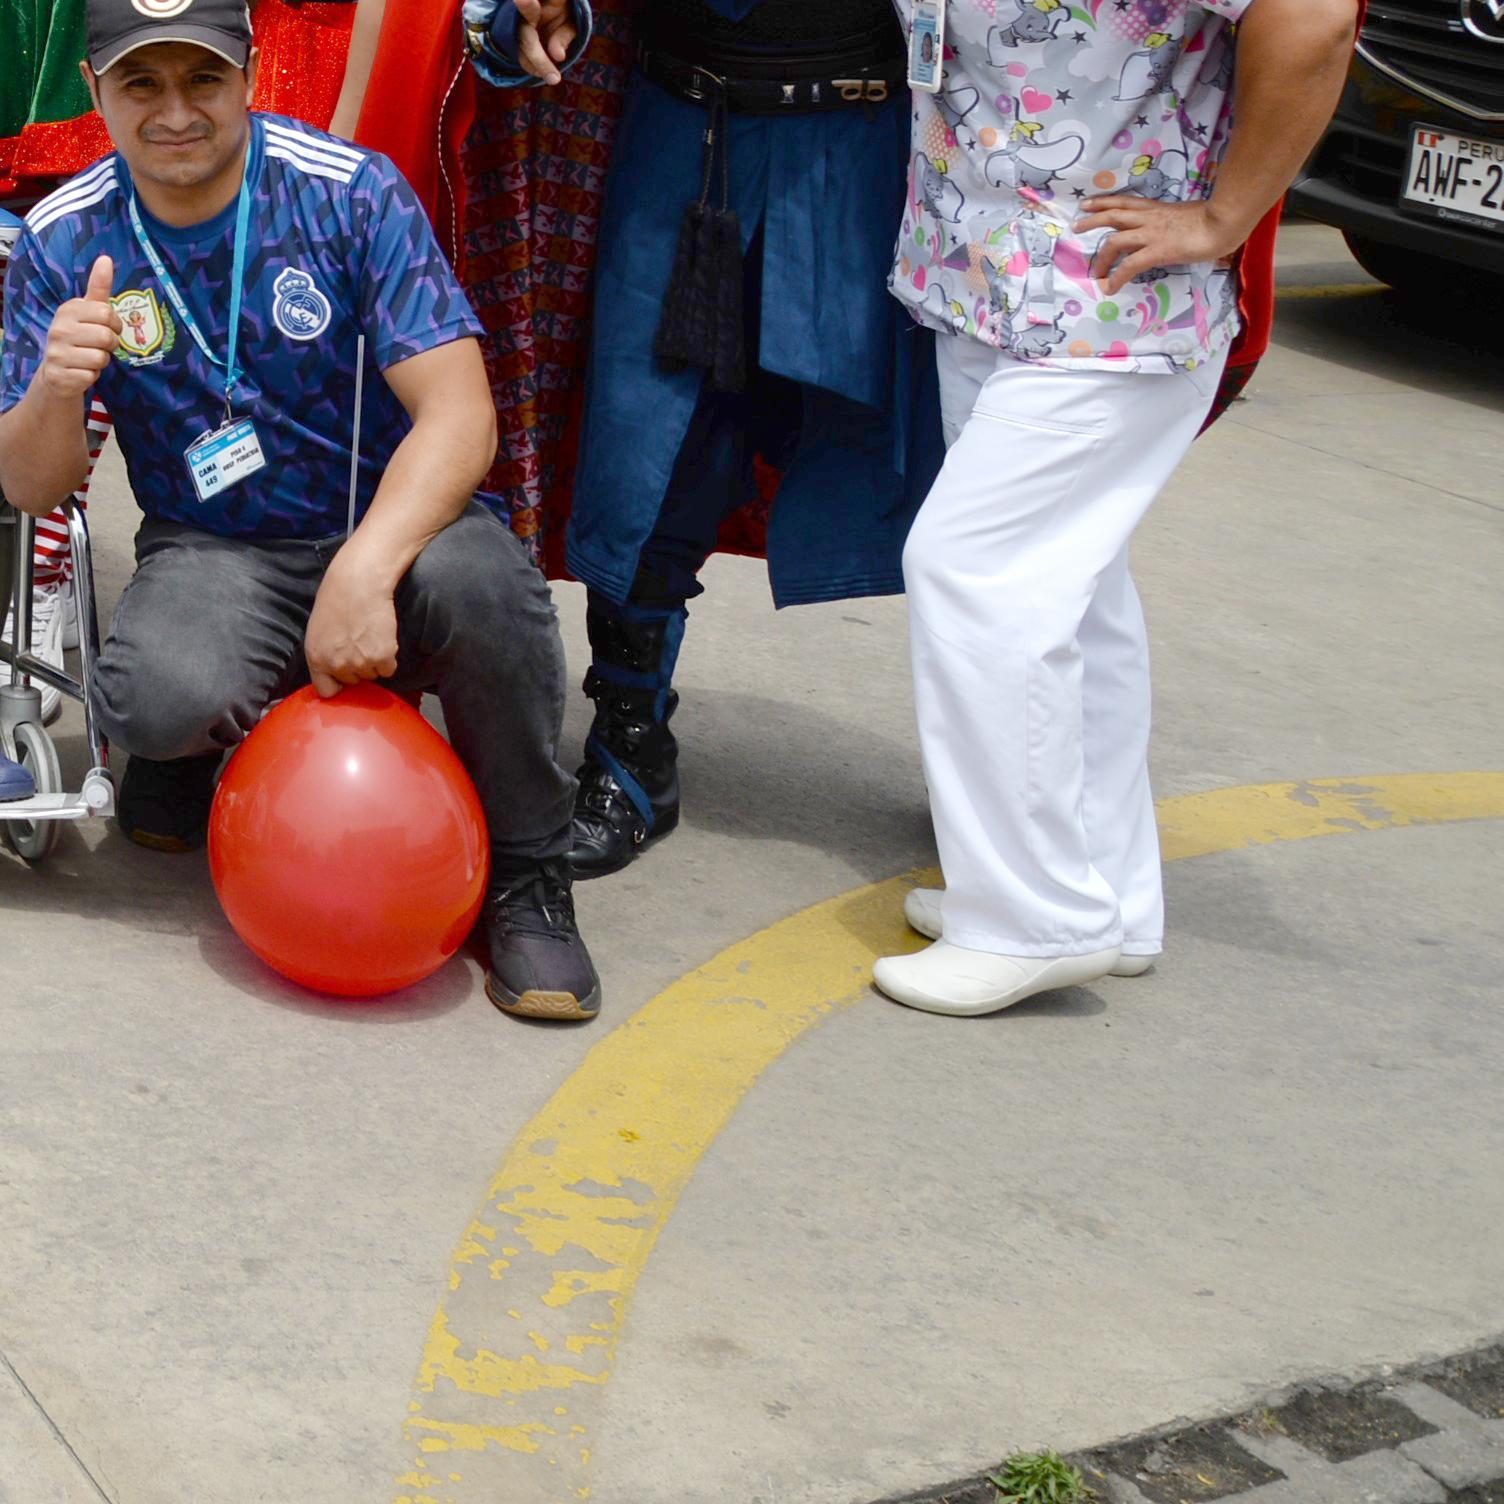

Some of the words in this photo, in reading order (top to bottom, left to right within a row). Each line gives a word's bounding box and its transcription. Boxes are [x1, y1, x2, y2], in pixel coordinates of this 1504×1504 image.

[1458, 140, 1504, 162] PERU
[1413, 148, 1504, 211] AWF-2
[198, 462, 218, 478] CAMA
